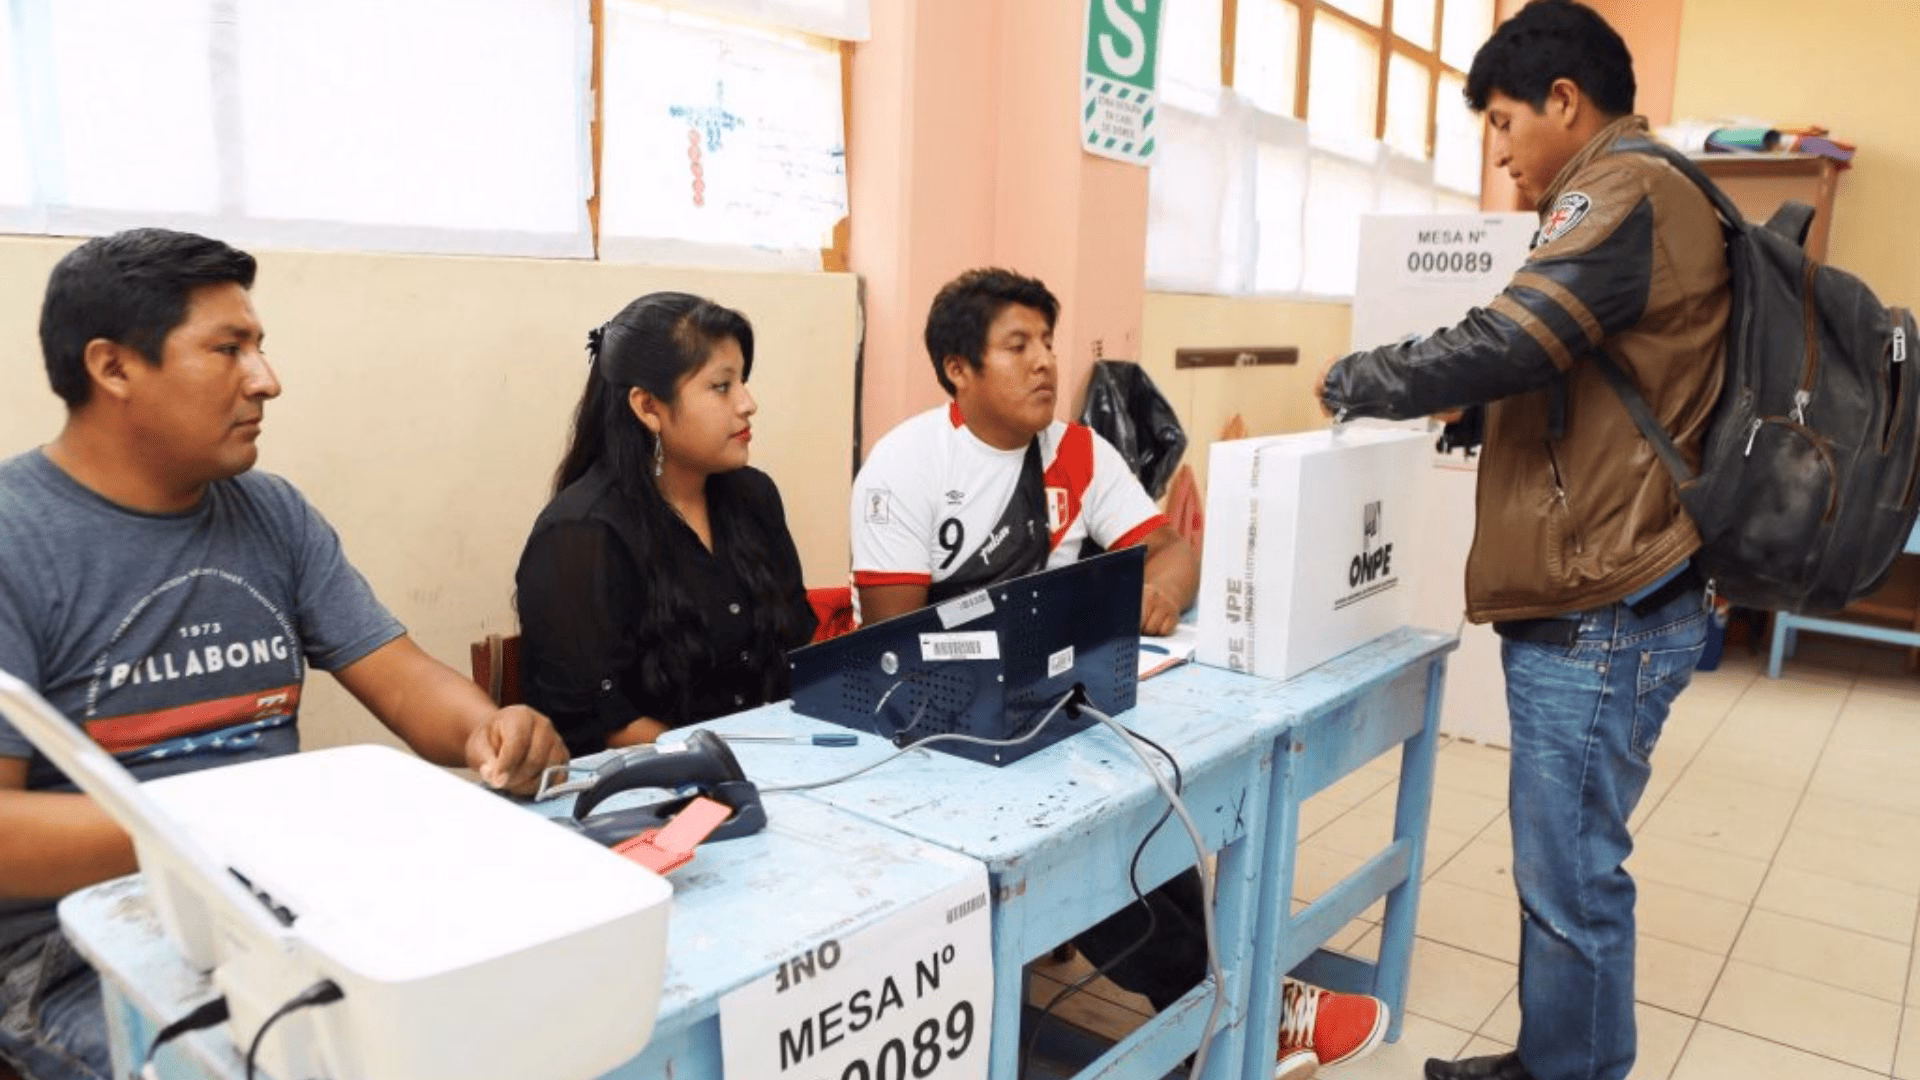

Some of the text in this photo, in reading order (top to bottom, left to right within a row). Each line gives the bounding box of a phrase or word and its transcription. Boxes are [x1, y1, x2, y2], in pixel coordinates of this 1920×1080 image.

[1098, 0, 1147, 78] S
[1418, 229, 1464, 244] MESA
[1407, 251, 1493, 273] 000089
[938, 516, 965, 570] 9
[1348, 542, 1393, 588] ONPE
[179, 622, 222, 638] 1973
[109, 635, 289, 690] BILLABONG
[778, 975, 905, 1072] MESA
